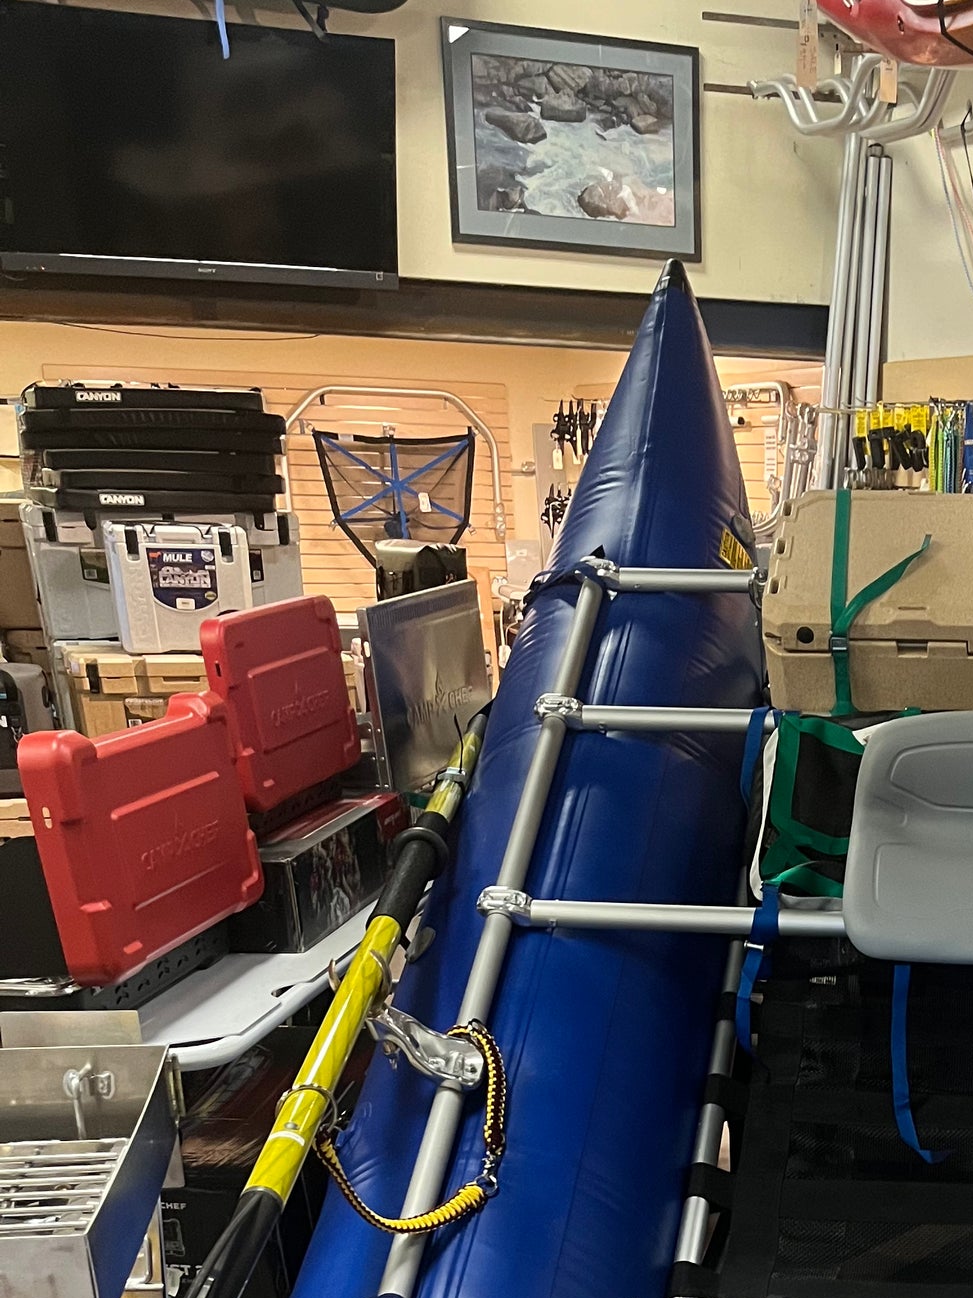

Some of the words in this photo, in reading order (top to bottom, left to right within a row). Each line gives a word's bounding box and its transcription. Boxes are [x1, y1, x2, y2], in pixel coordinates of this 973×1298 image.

[76, 391, 122, 402] CANYON
[99, 493, 145, 506] CANYON
[163, 552, 193, 563] MULE
